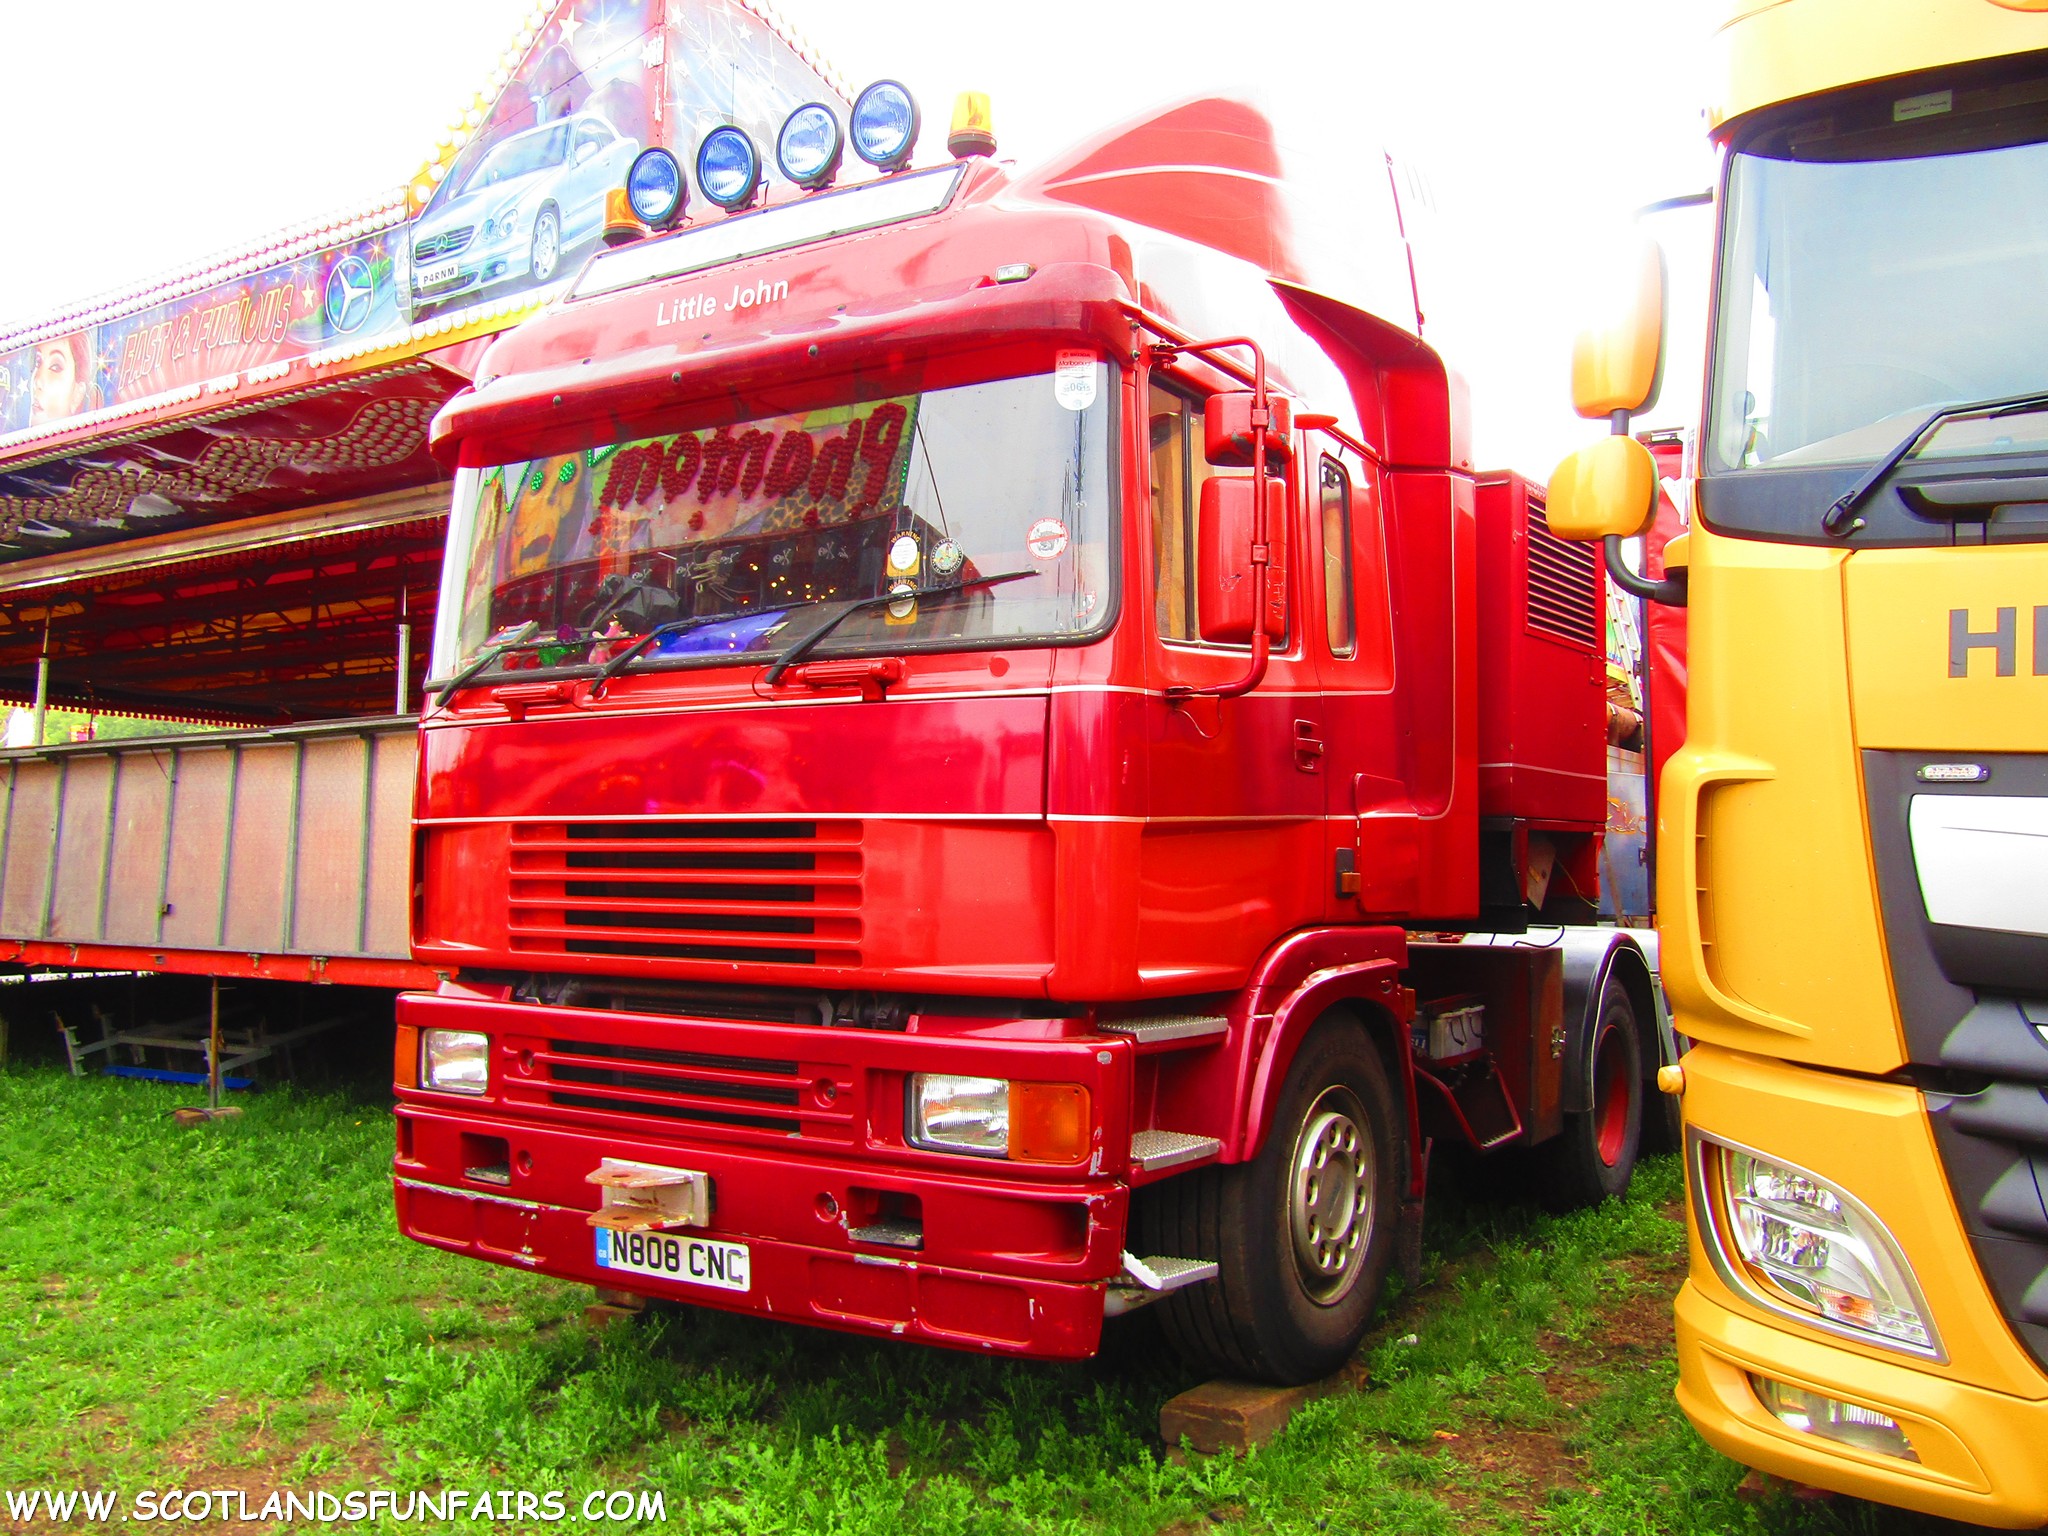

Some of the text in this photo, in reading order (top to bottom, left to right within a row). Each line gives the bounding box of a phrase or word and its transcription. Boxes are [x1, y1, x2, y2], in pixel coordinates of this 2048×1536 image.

[423, 266, 455, 284] P4RNM
[656, 277, 789, 327] Little John
[117, 283, 294, 392] FAST & FURIOUS
[890, 530, 921, 543] WARNING
[888, 578, 918, 591] WARNING
[613, 1230, 680, 1272] N808
